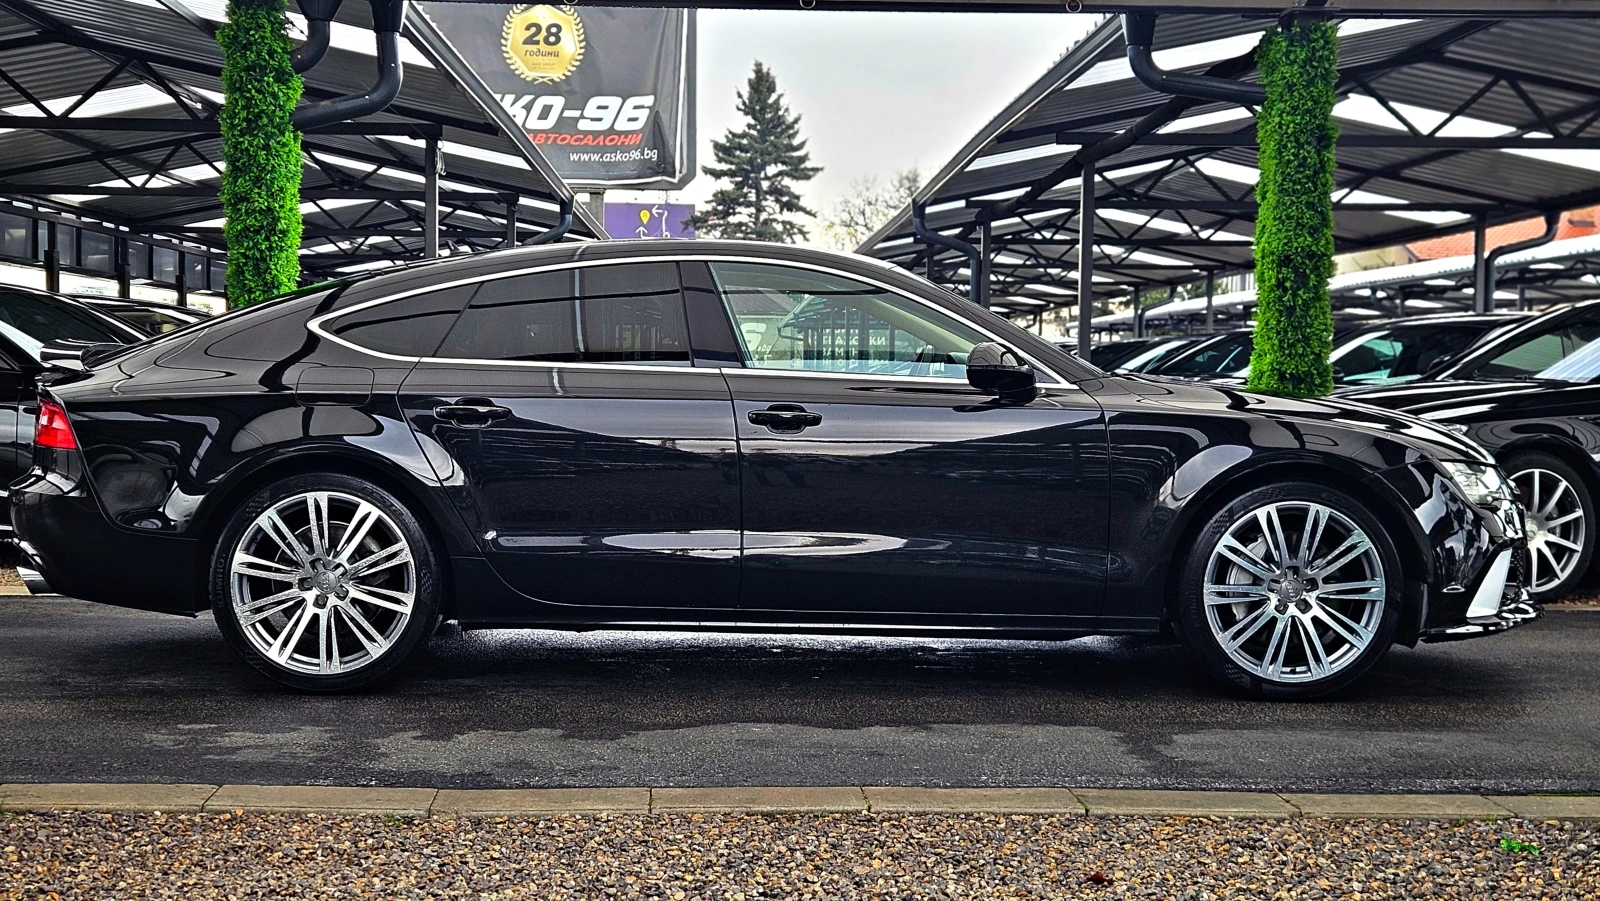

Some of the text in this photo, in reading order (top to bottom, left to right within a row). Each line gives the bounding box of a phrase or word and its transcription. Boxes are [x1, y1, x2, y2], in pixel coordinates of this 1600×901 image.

[522, 22, 562, 46] 28
[524, 48, 560, 57] години
[494, 94, 655, 131] KO-96
[569, 147, 658, 161] www.asko96.bg
